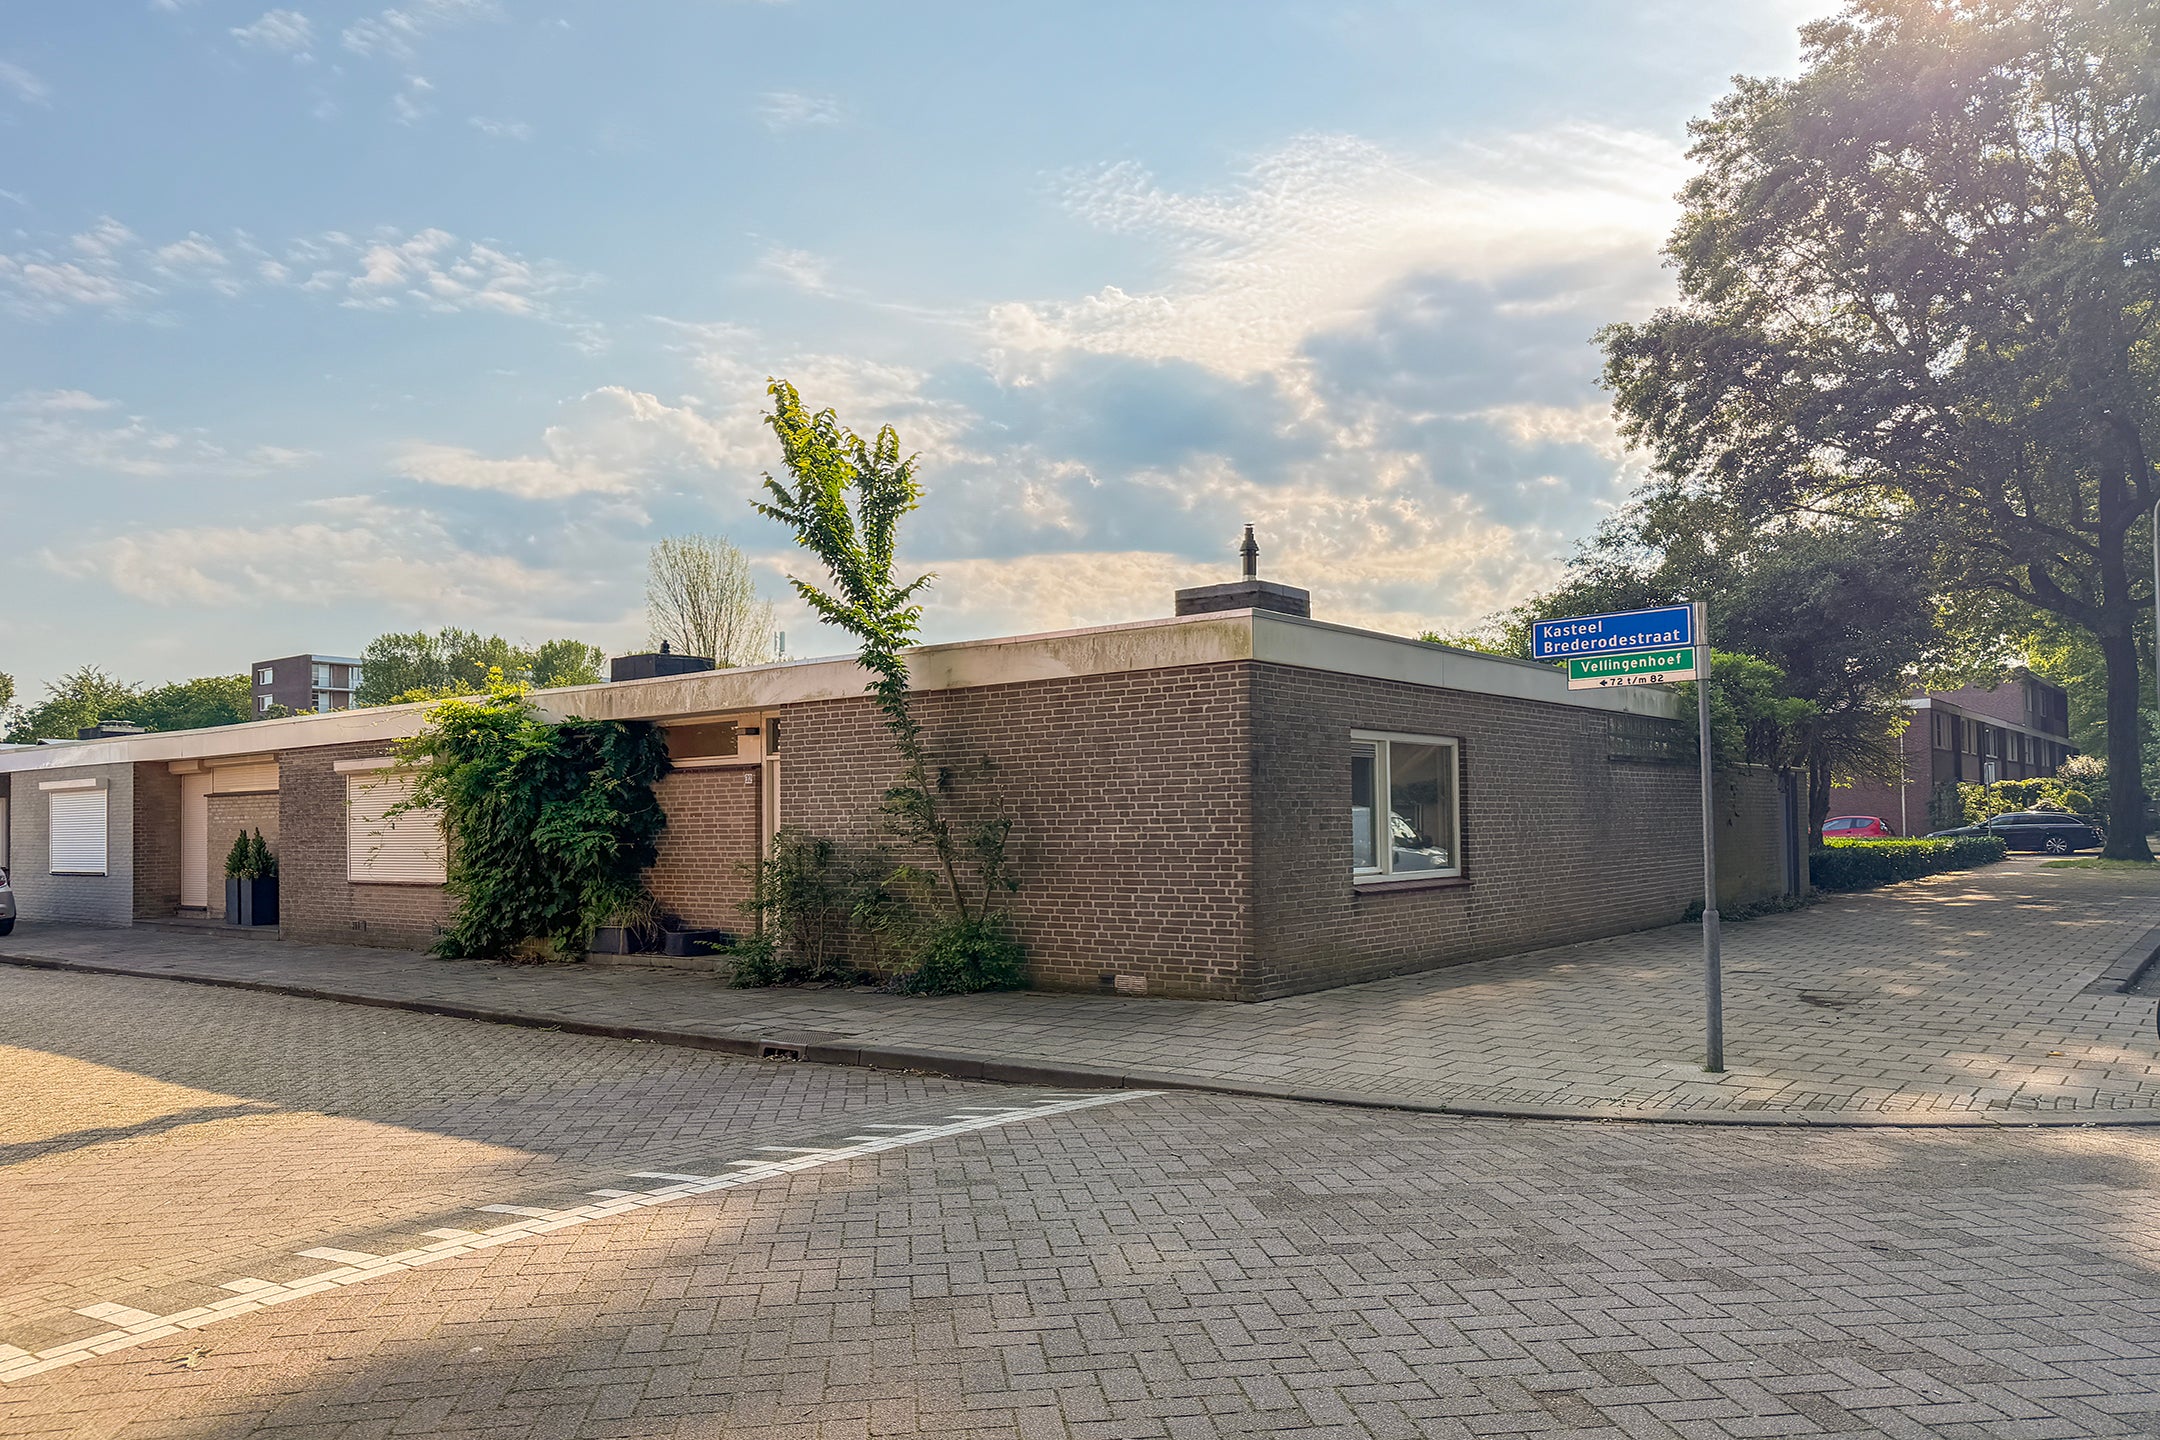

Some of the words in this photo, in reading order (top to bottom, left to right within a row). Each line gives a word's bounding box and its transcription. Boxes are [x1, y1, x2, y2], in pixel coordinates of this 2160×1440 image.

[1543, 621, 1603, 638] Kasteel
[1544, 629, 1680, 653] Brederodestraat
[1580, 653, 1682, 673] Vellingenhoef
[1610, 678, 1623, 686] 72
[1627, 677, 1647, 685] t/m
[1650, 674, 1664, 683] 82
